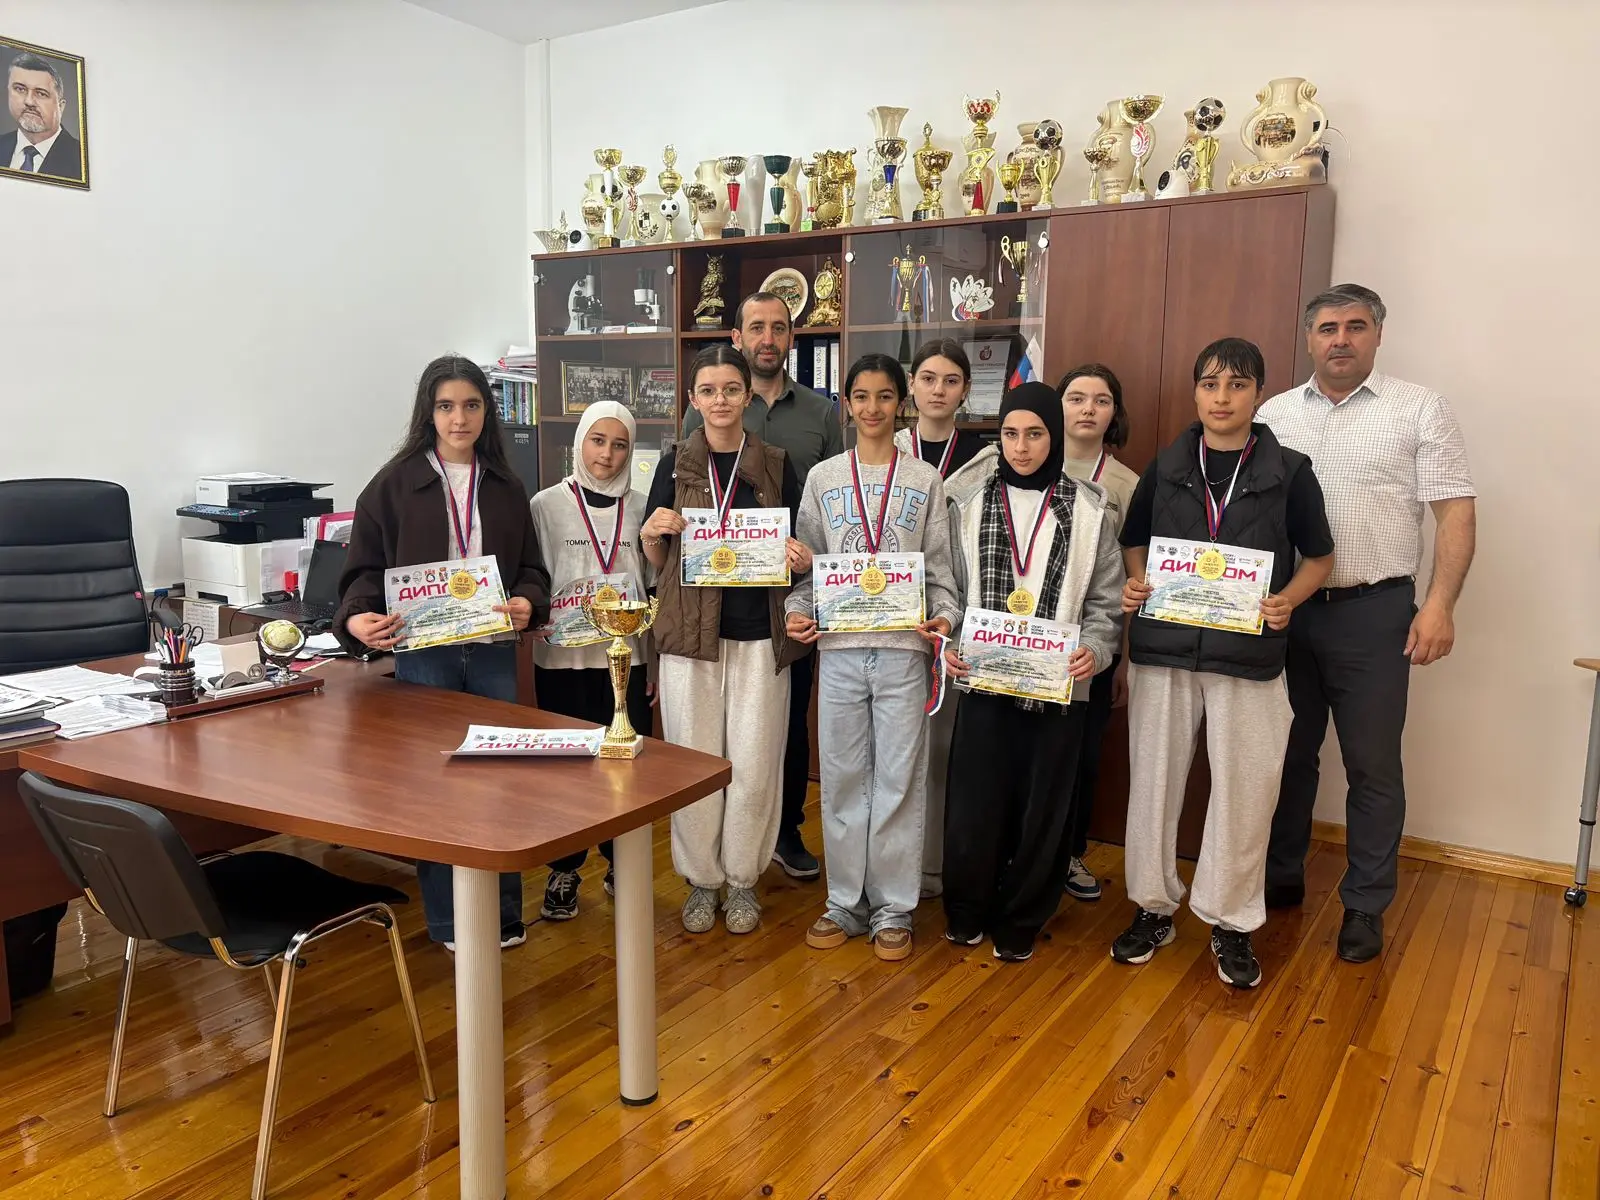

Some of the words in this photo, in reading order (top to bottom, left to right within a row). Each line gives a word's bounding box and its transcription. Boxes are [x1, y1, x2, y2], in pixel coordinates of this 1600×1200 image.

[821, 484, 928, 532] CUTE
[693, 527, 778, 540] ДИПЛОМ
[825, 572, 913, 586] ДИПОМ
[972, 629, 1065, 653] ДИПЛОМ
